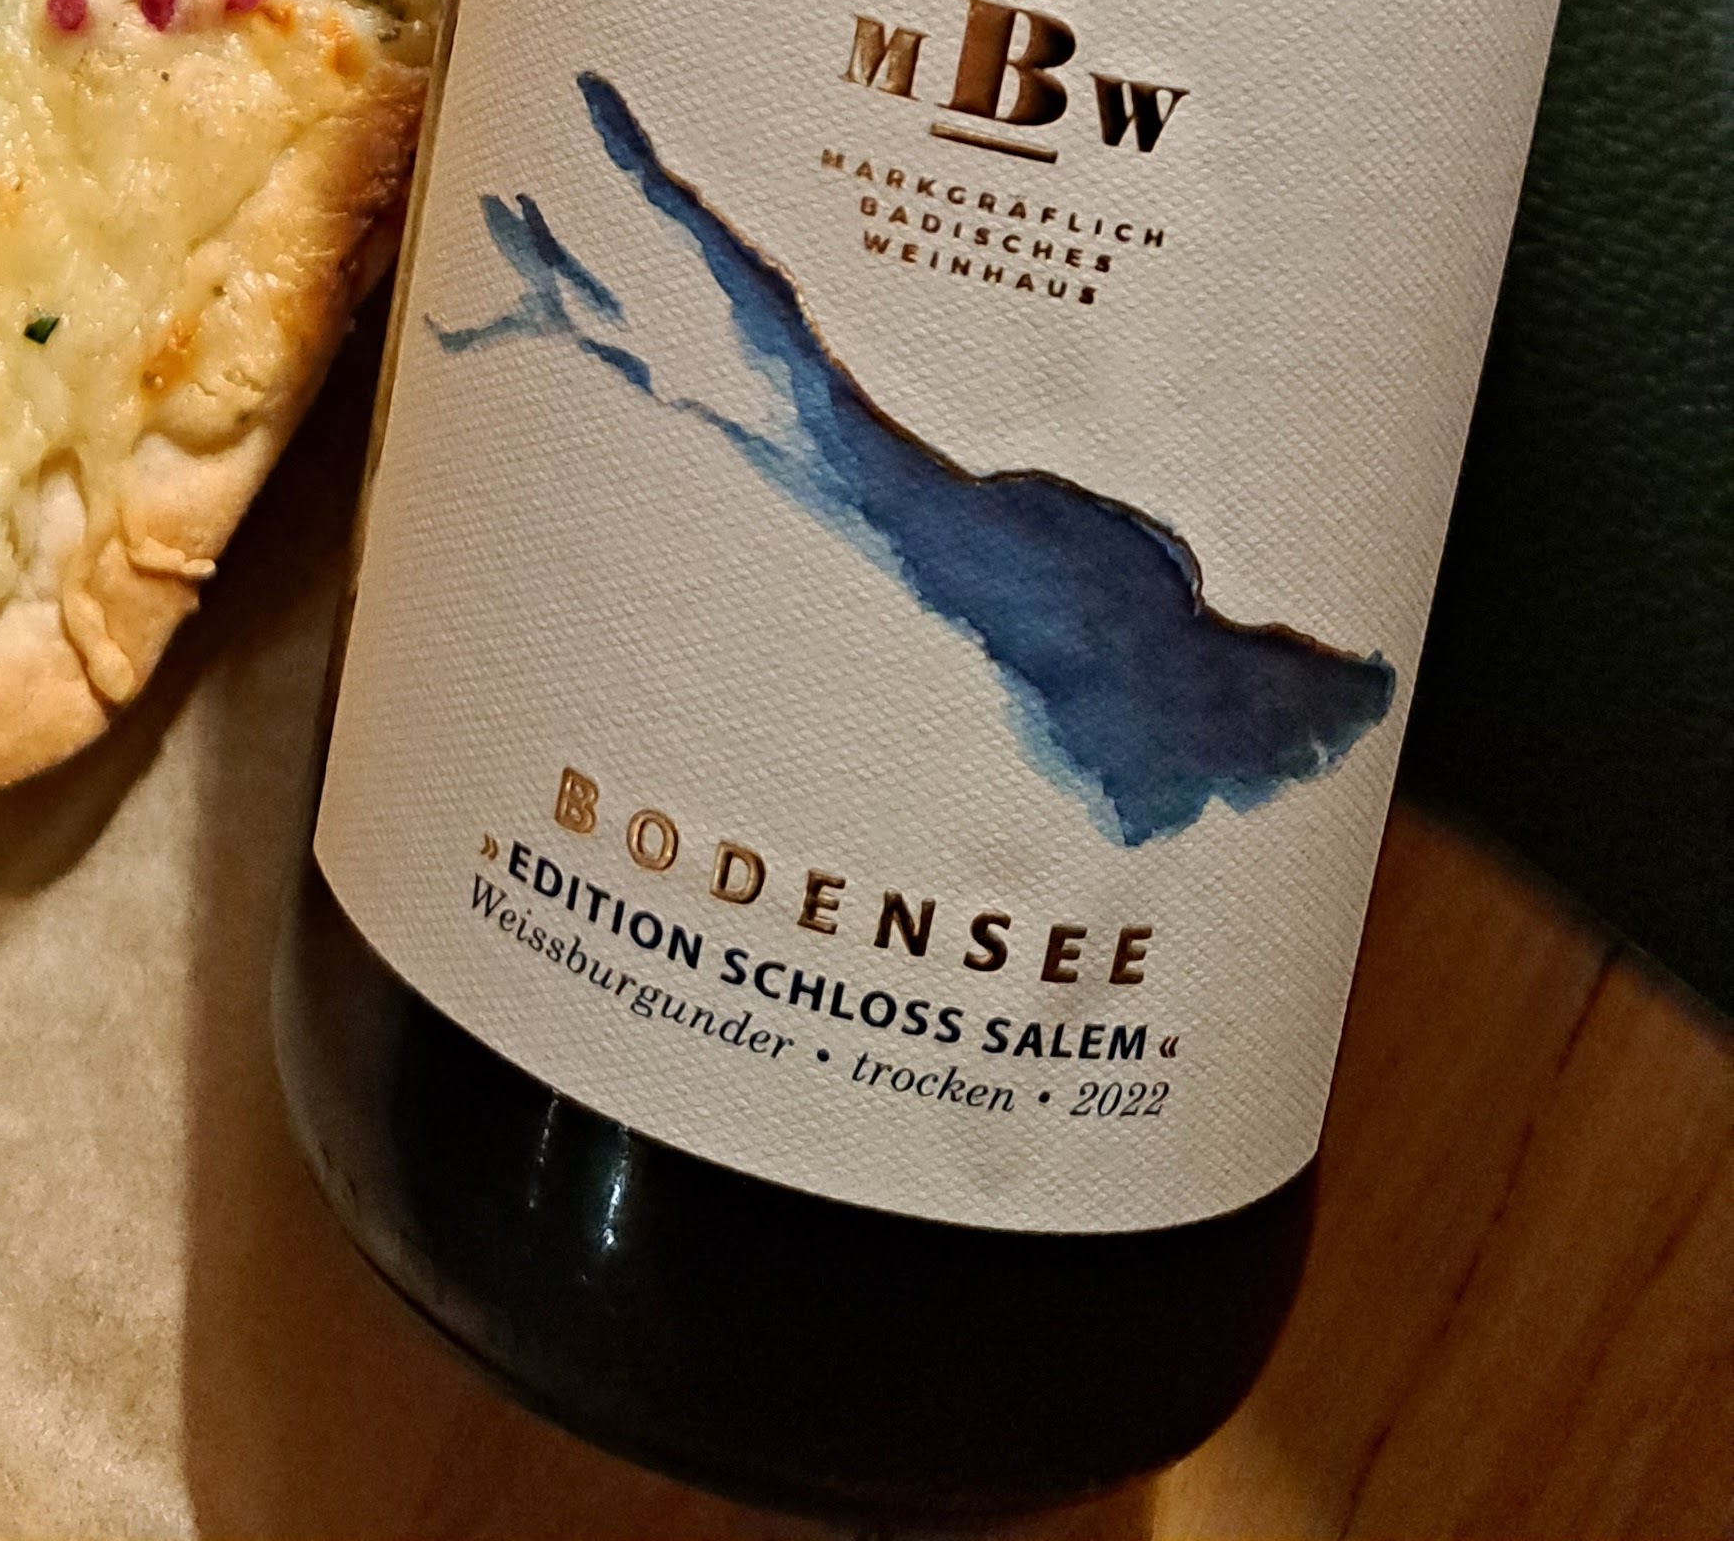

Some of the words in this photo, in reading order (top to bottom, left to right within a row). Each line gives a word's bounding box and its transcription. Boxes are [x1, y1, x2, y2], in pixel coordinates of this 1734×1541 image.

[860, 196, 1113, 273] BADISCHES
[863, 230, 1097, 305] WEINHAUS
[554, 767, 1153, 985] BODENSEE
[469, 873, 796, 1062] Weissburgunder
[852, 1050, 1016, 1113] trocken
[1070, 1081, 1171, 1119] 2022
[720, 947, 965, 1044] SCHLOSS
